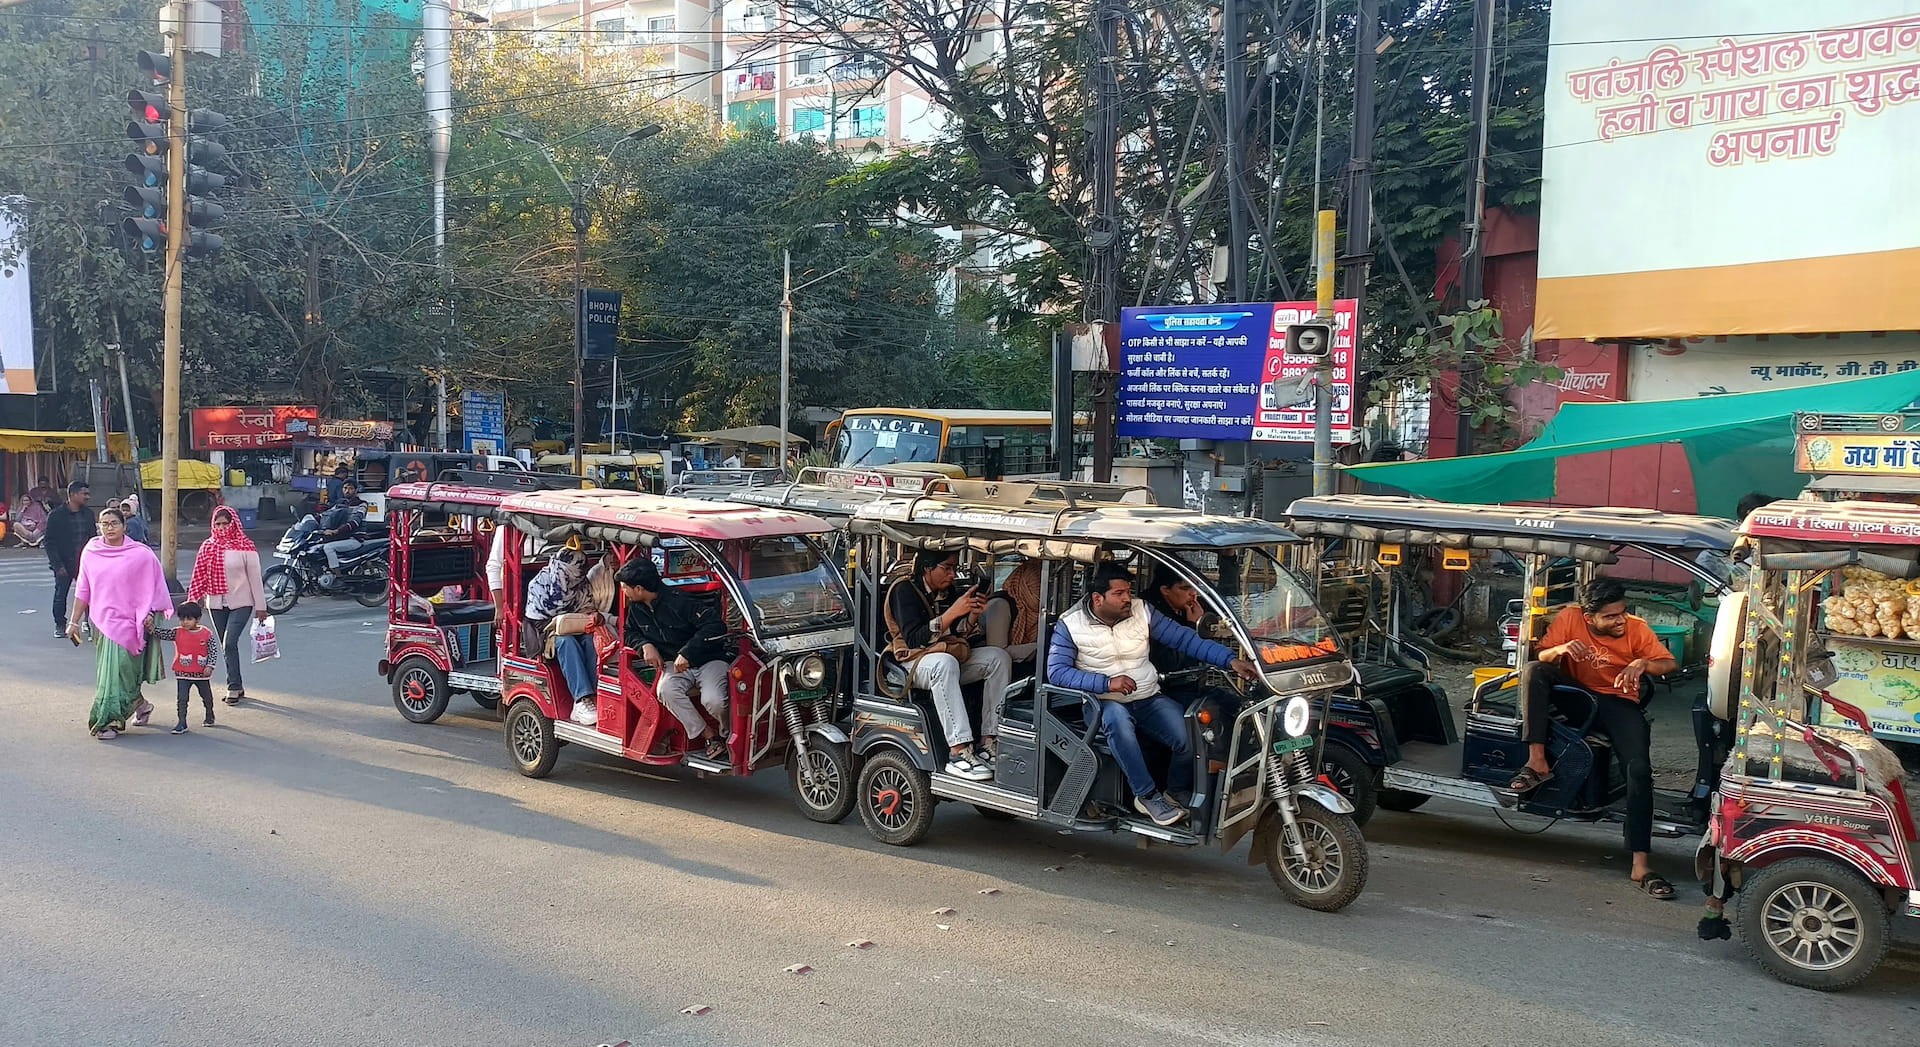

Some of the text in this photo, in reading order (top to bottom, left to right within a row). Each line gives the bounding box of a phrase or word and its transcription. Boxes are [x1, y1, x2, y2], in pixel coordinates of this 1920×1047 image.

[1569, 50, 1688, 99] पतंजलि
[1694, 39, 1810, 80] स्पेशल
[1599, 94, 1657, 140] हनी
[1666, 96, 1695, 127] व
[1702, 84, 1770, 122] गाय
[1778, 76, 1837, 110] का
[1710, 112, 1841, 164] अपनाएं
[589, 302, 618, 312] BHOPAL
[588, 314, 617, 324] POLICE
[1128, 338, 1141, 347] OTP
[1142, 337, 1158, 347] किसी
[1159, 337, 1164, 346] से
[1165, 336, 1173, 346] भी
[1174, 338, 1189, 348] साझा
[1190, 338, 1195, 346] न
[1196, 336, 1206, 346] करें
[1226, 336, 1247, 346] आपकी
[1127, 354, 1143, 364] सुरक्षा
[1144, 352, 1152, 362] की
[1127, 367, 1140, 377] फर्जी
[1141, 367, 1154, 377] कॉल
[1155, 367, 1167, 377] और
[1167, 367, 1180, 377] लिंक
[1182, 367, 1188, 377] से
[1202, 367, 1218, 378] सतर्क
[1750, 365, 1773, 381] न्यू
[1127, 382, 1148, 393] अजनबी
[1149, 382, 1162, 393] लिंक
[1172, 382, 1189, 393] क्लिक
[1190, 385, 1206, 393] करना
[1207, 383, 1221, 394] खतरे
[1223, 386, 1231, 394] का
[1232, 383, 1249, 394] संकेत
[1126, 398, 1146, 408] पासवर्ड
[1147, 400, 1165, 410] मजबूत
[1184, 400, 1201, 411] सुरक्षा
[1126, 412, 1143, 422] सोशल
[1144, 412, 1163, 423] मीडिया
[1164, 415, 1172, 423] पर
[1173, 416, 1189, 424] ज्यादा
[1191, 414, 1217, 425] जानकारी
[1217, 417, 1233, 426] साझा
[1234, 417, 1240, 425] न
[851, 418, 929, 435] L.N.C.T.
[1844, 446, 1878, 466] जय
[1515, 518, 1556, 528] YATRI
[1804, 814, 1841, 826] yatri
